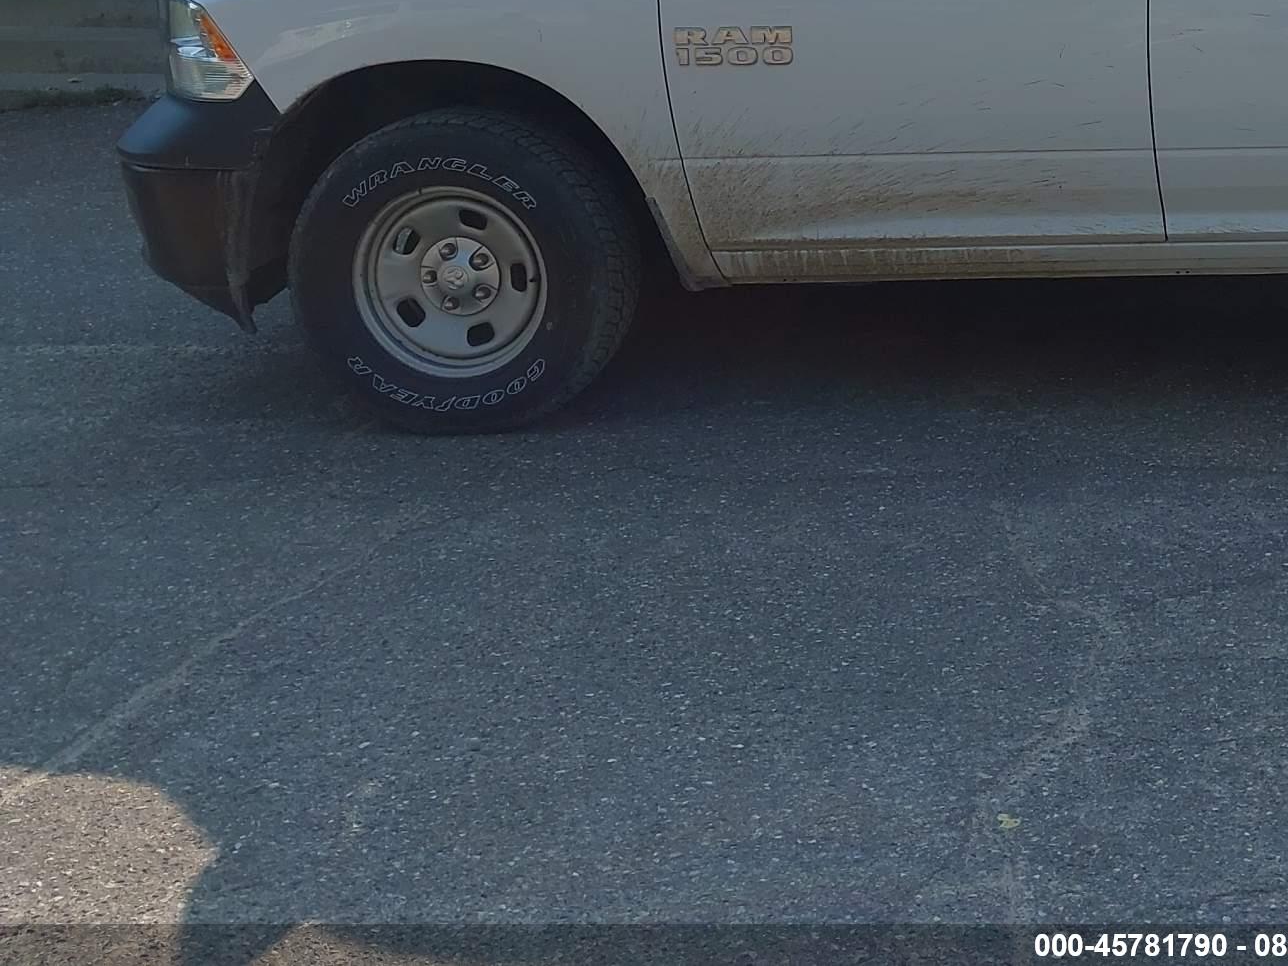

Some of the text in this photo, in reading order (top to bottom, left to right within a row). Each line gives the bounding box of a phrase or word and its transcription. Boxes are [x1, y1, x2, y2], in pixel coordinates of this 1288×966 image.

[673, 25, 794, 45] RAM
[675, 46, 794, 66] 1500
[342, 156, 537, 210] WRANGLER
[347, 355, 546, 412] GOODYEAR
